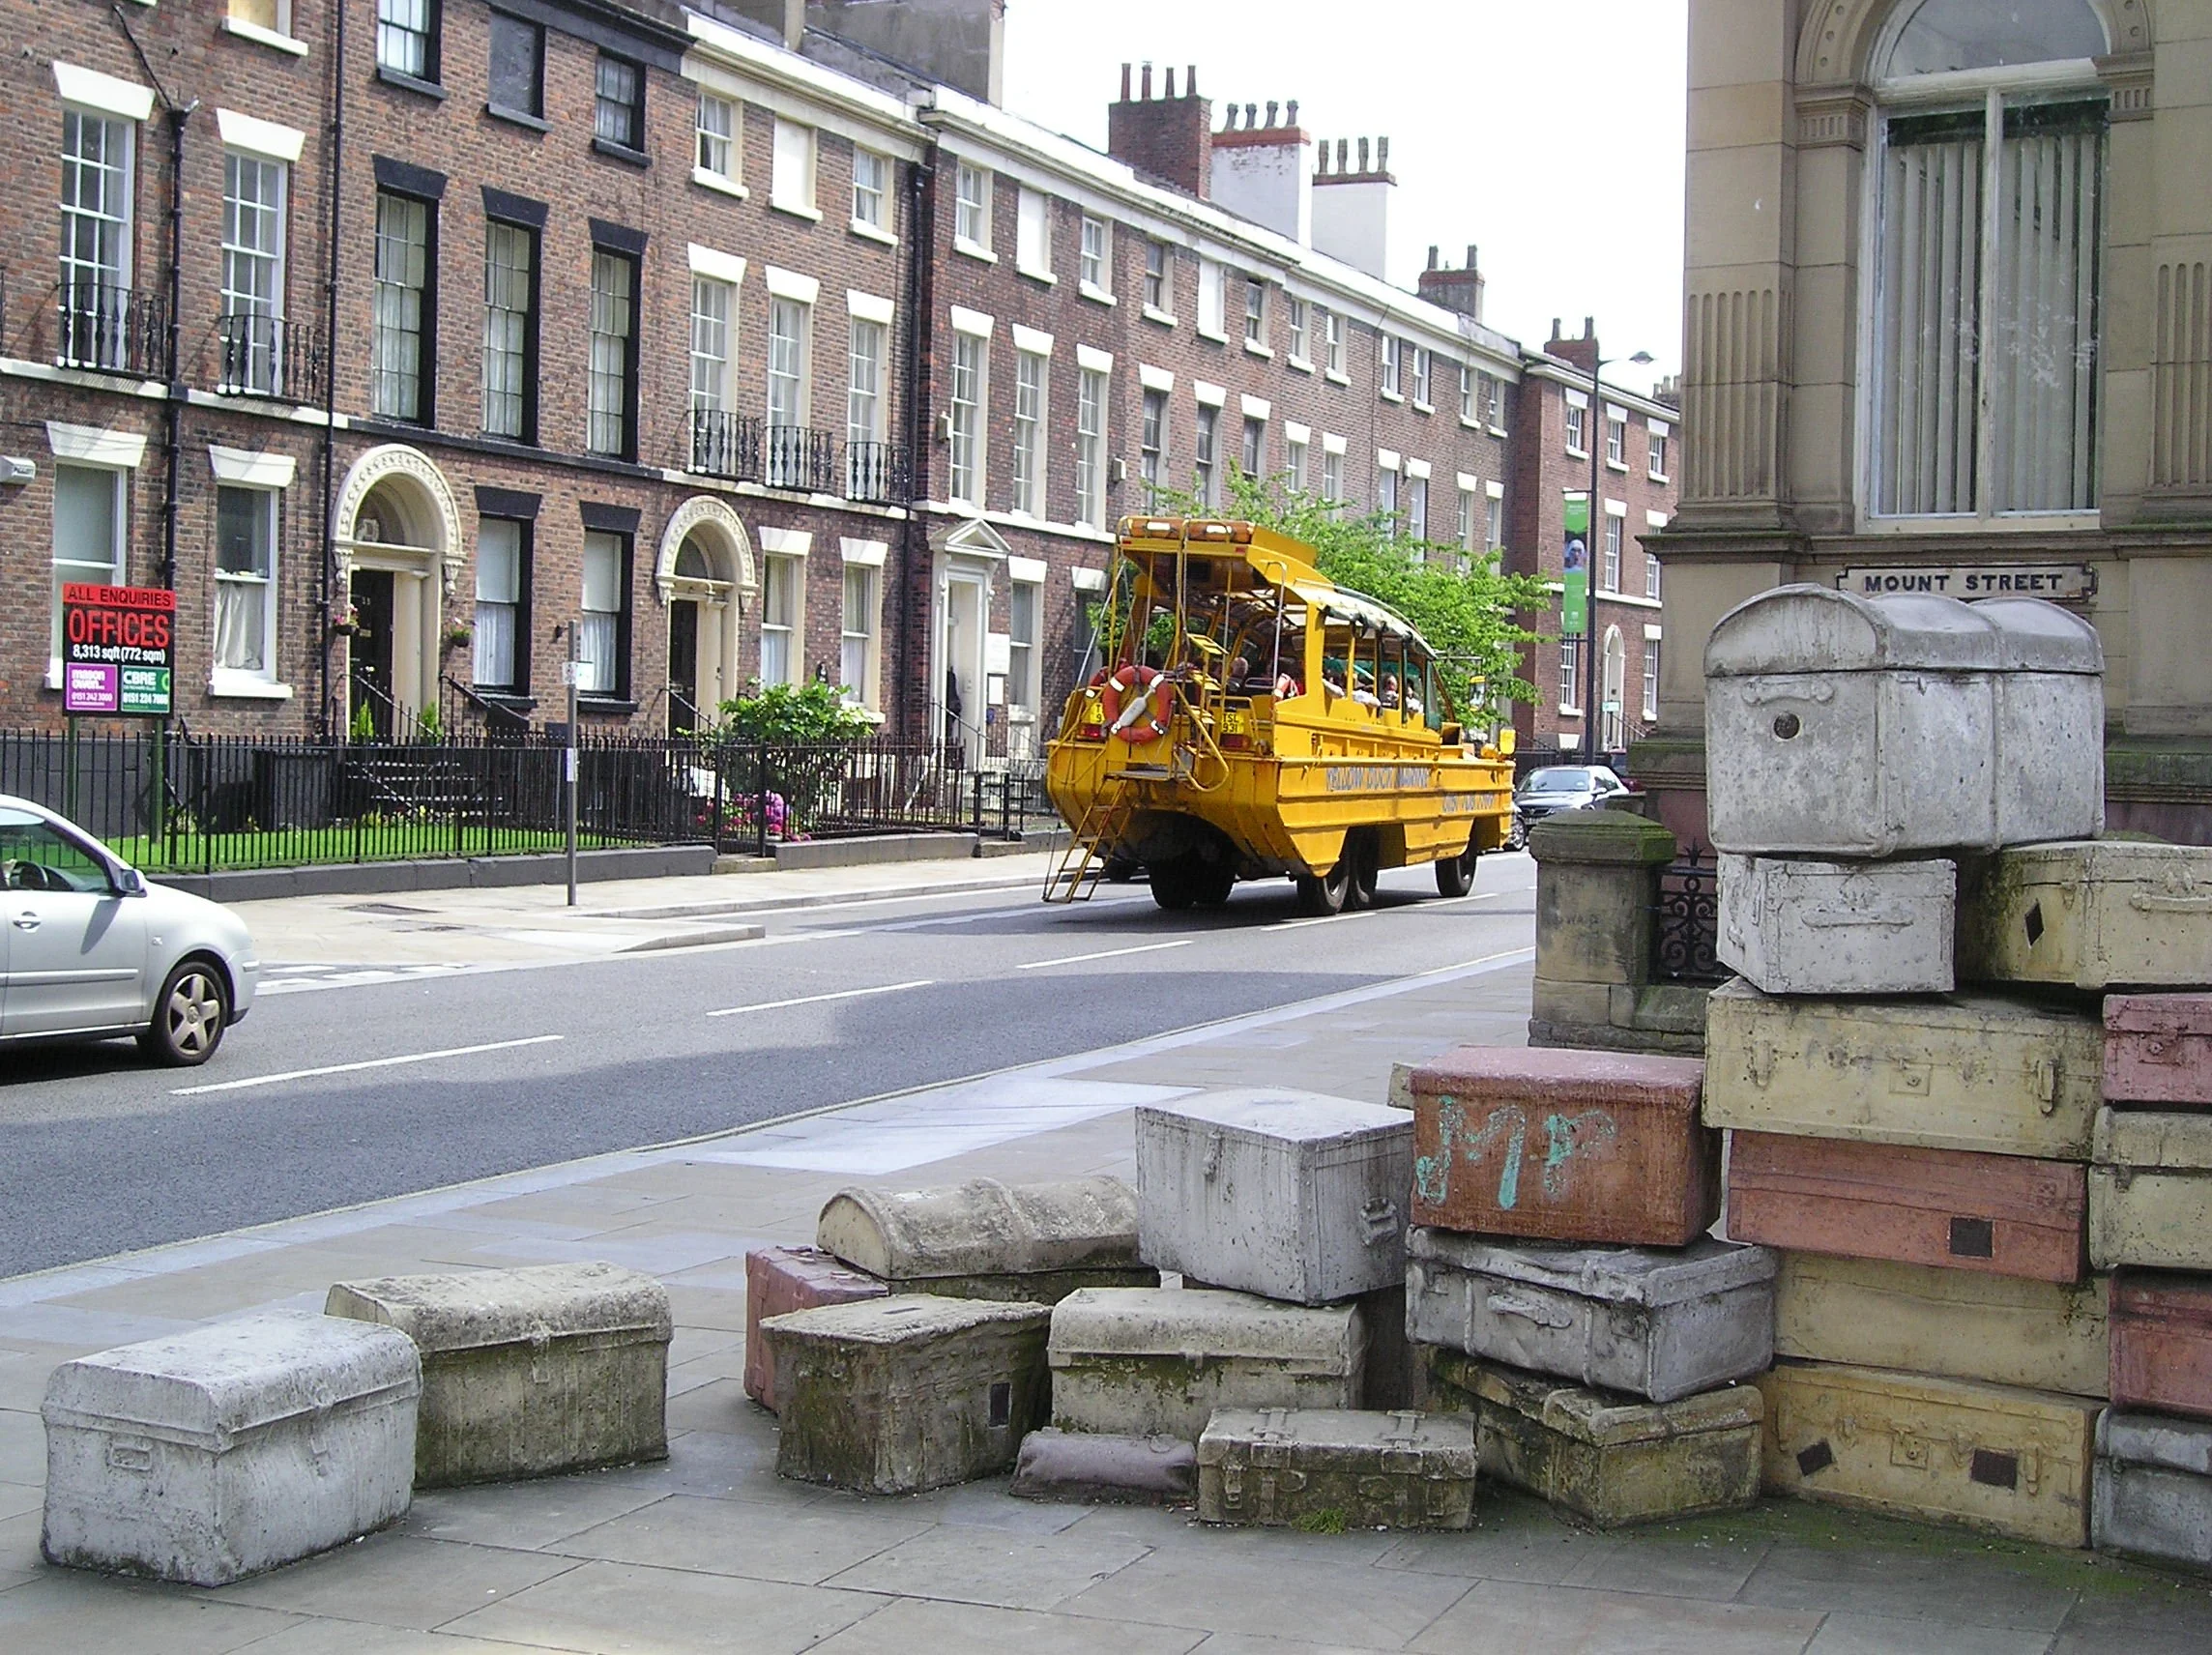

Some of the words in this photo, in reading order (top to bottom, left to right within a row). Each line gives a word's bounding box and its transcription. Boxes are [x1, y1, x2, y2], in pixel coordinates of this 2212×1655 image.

[1865, 575, 1950, 592] MOUNT
[1965, 573, 2062, 591] STREET
[69, 588, 94, 601] ALL
[100, 589, 171, 607] ENQUIRIES
[70, 609, 169, 647] OFFICES
[73, 644, 101, 660] 8,313
[102, 647, 120, 661] sqft
[121, 647, 141, 662] (772
[142, 649, 165, 664] sqm)
[124, 671, 157, 685] CBRE
[1223, 713, 1239, 723] TSL
[1223, 722, 1237, 733] 931
